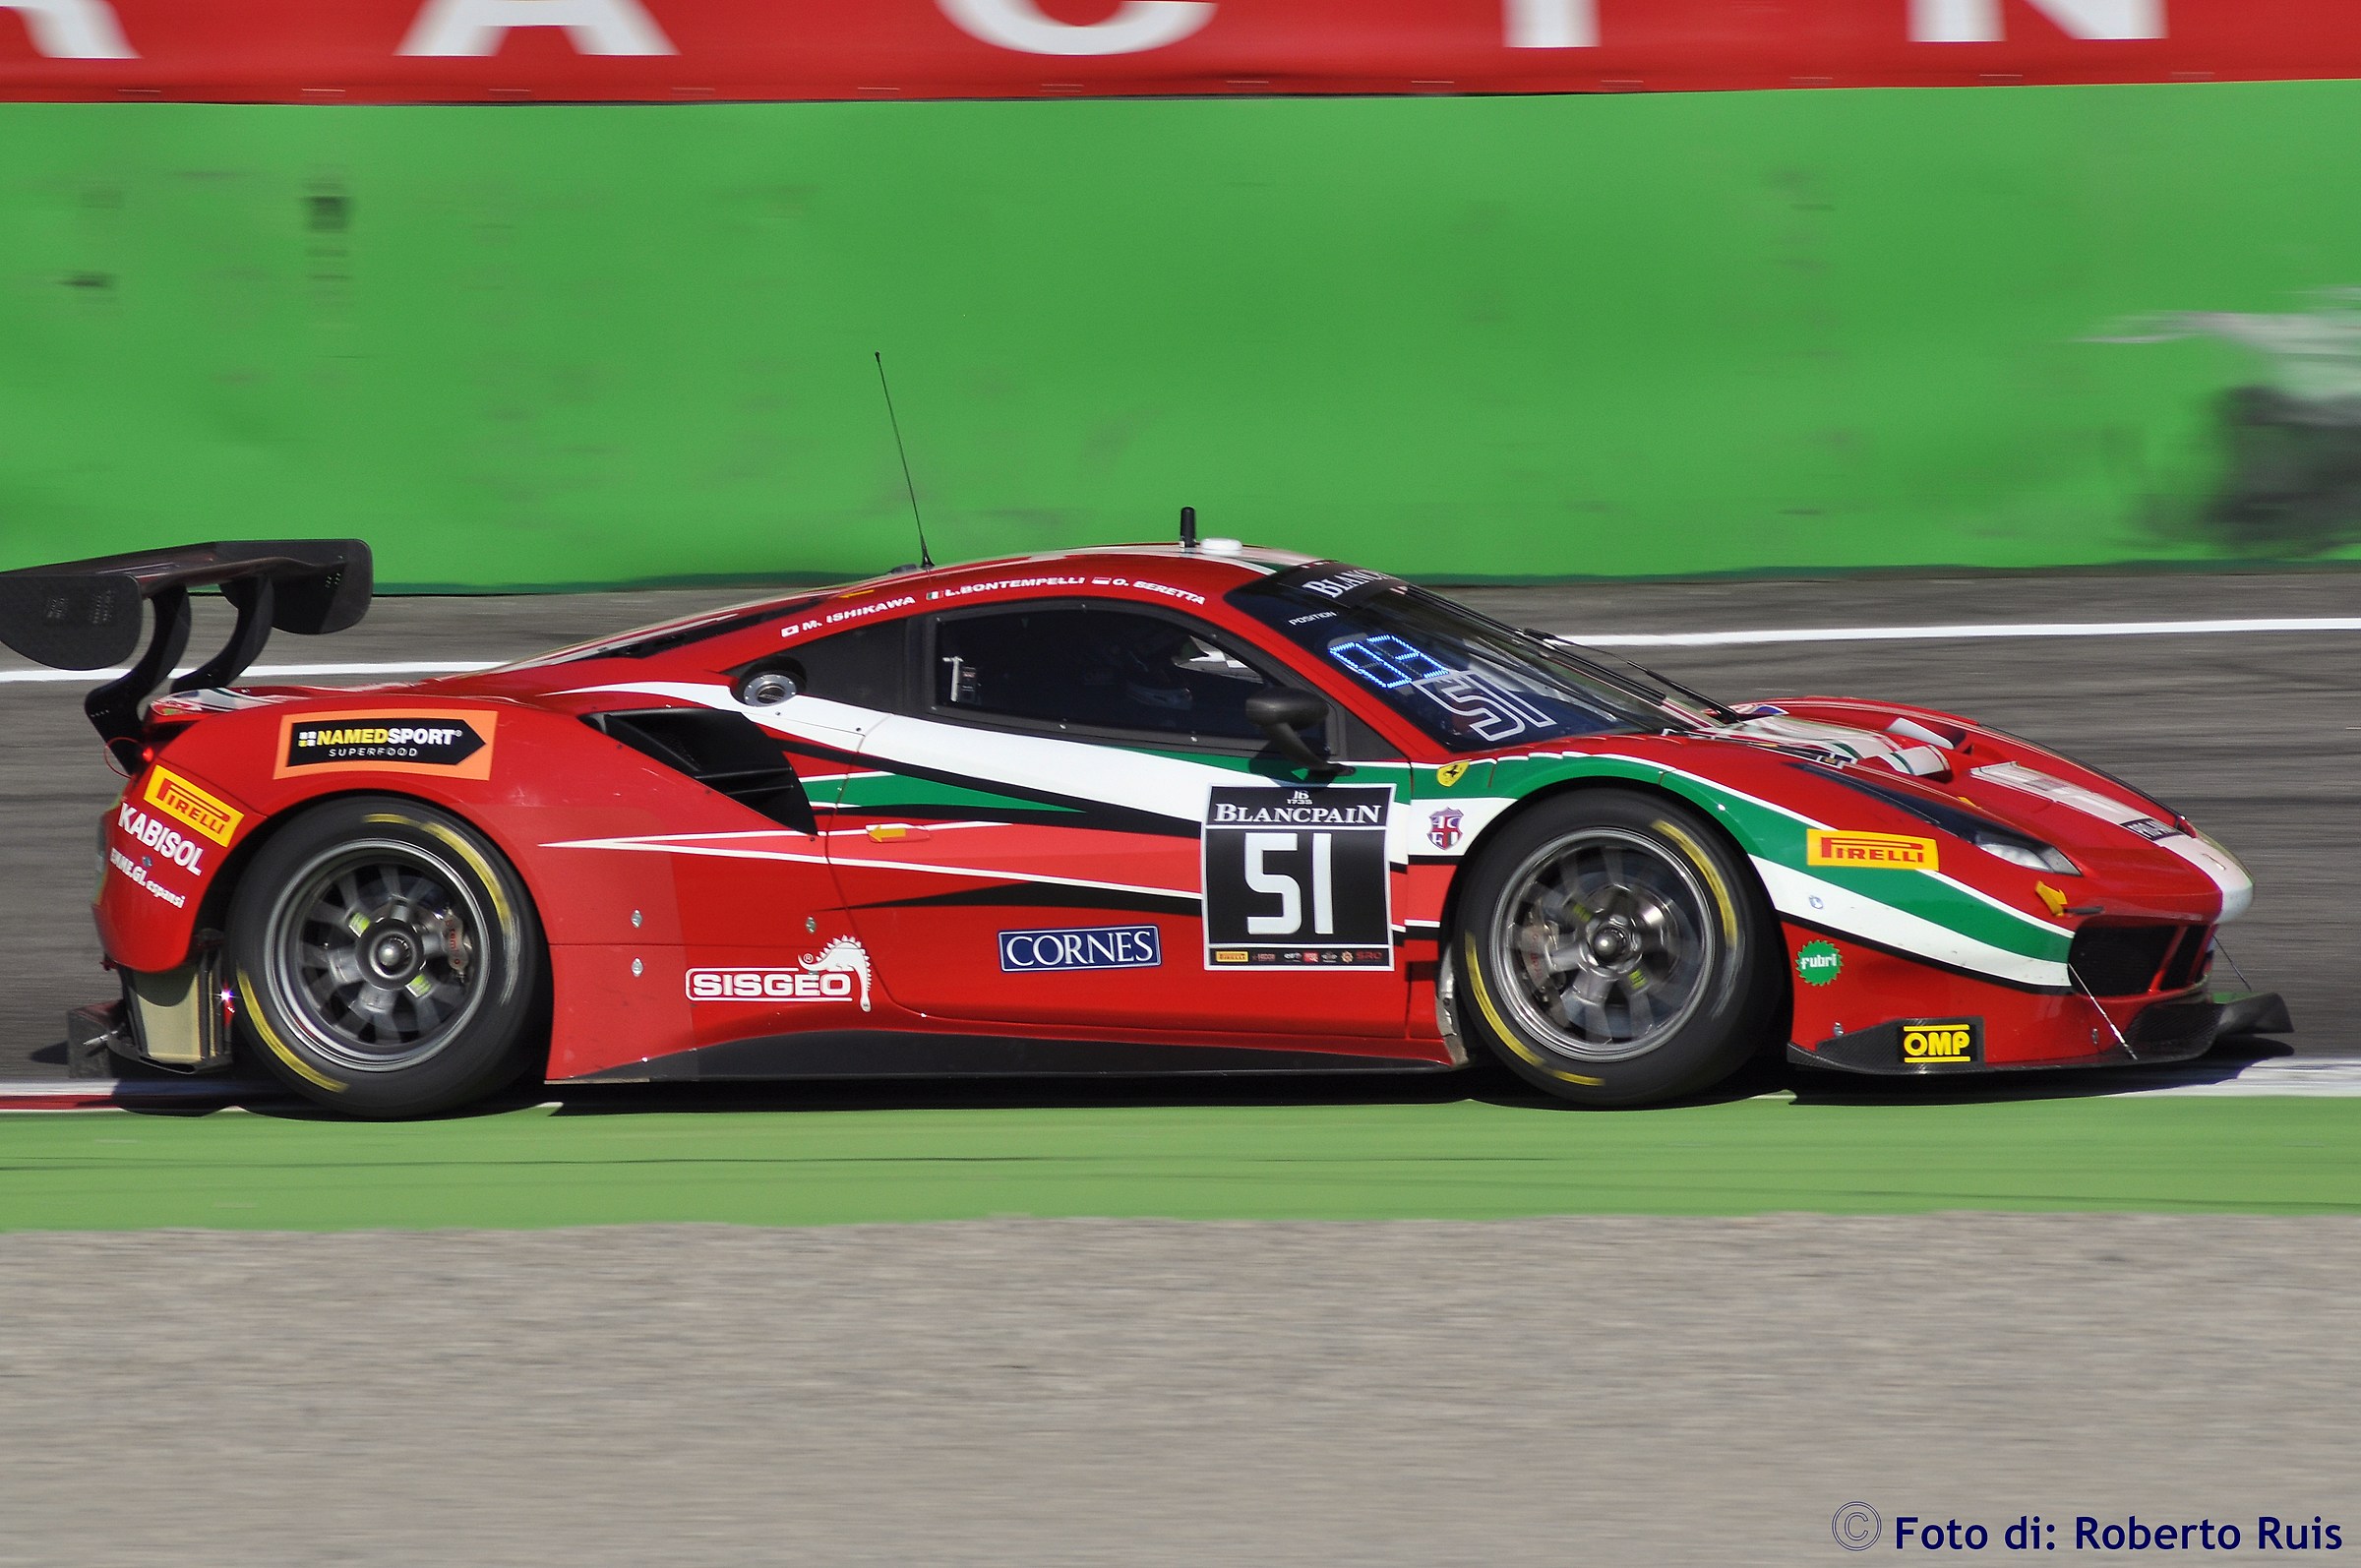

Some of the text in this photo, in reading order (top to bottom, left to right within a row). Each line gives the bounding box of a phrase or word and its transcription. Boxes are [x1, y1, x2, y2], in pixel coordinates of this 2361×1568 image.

[1112, 577, 1206, 605] O. BERETTA
[802, 596, 916, 632] M. ISHIKAWA
[1288, 611, 1339, 626] POSITION
[1411, 673, 1557, 742] 51
[329, 747, 418, 757] SUPERFOOD
[156, 777, 231, 835] PIRELLI
[1214, 803, 1382, 824] BLANCPAIN
[118, 802, 204, 876] KABISOL
[1821, 835, 1924, 864] PIRELLI
[1244, 832, 1334, 935] 51
[1005, 931, 1153, 966] CORNES
[693, 973, 852, 996] SISGEO
[1904, 1031, 1970, 1056] OMP
